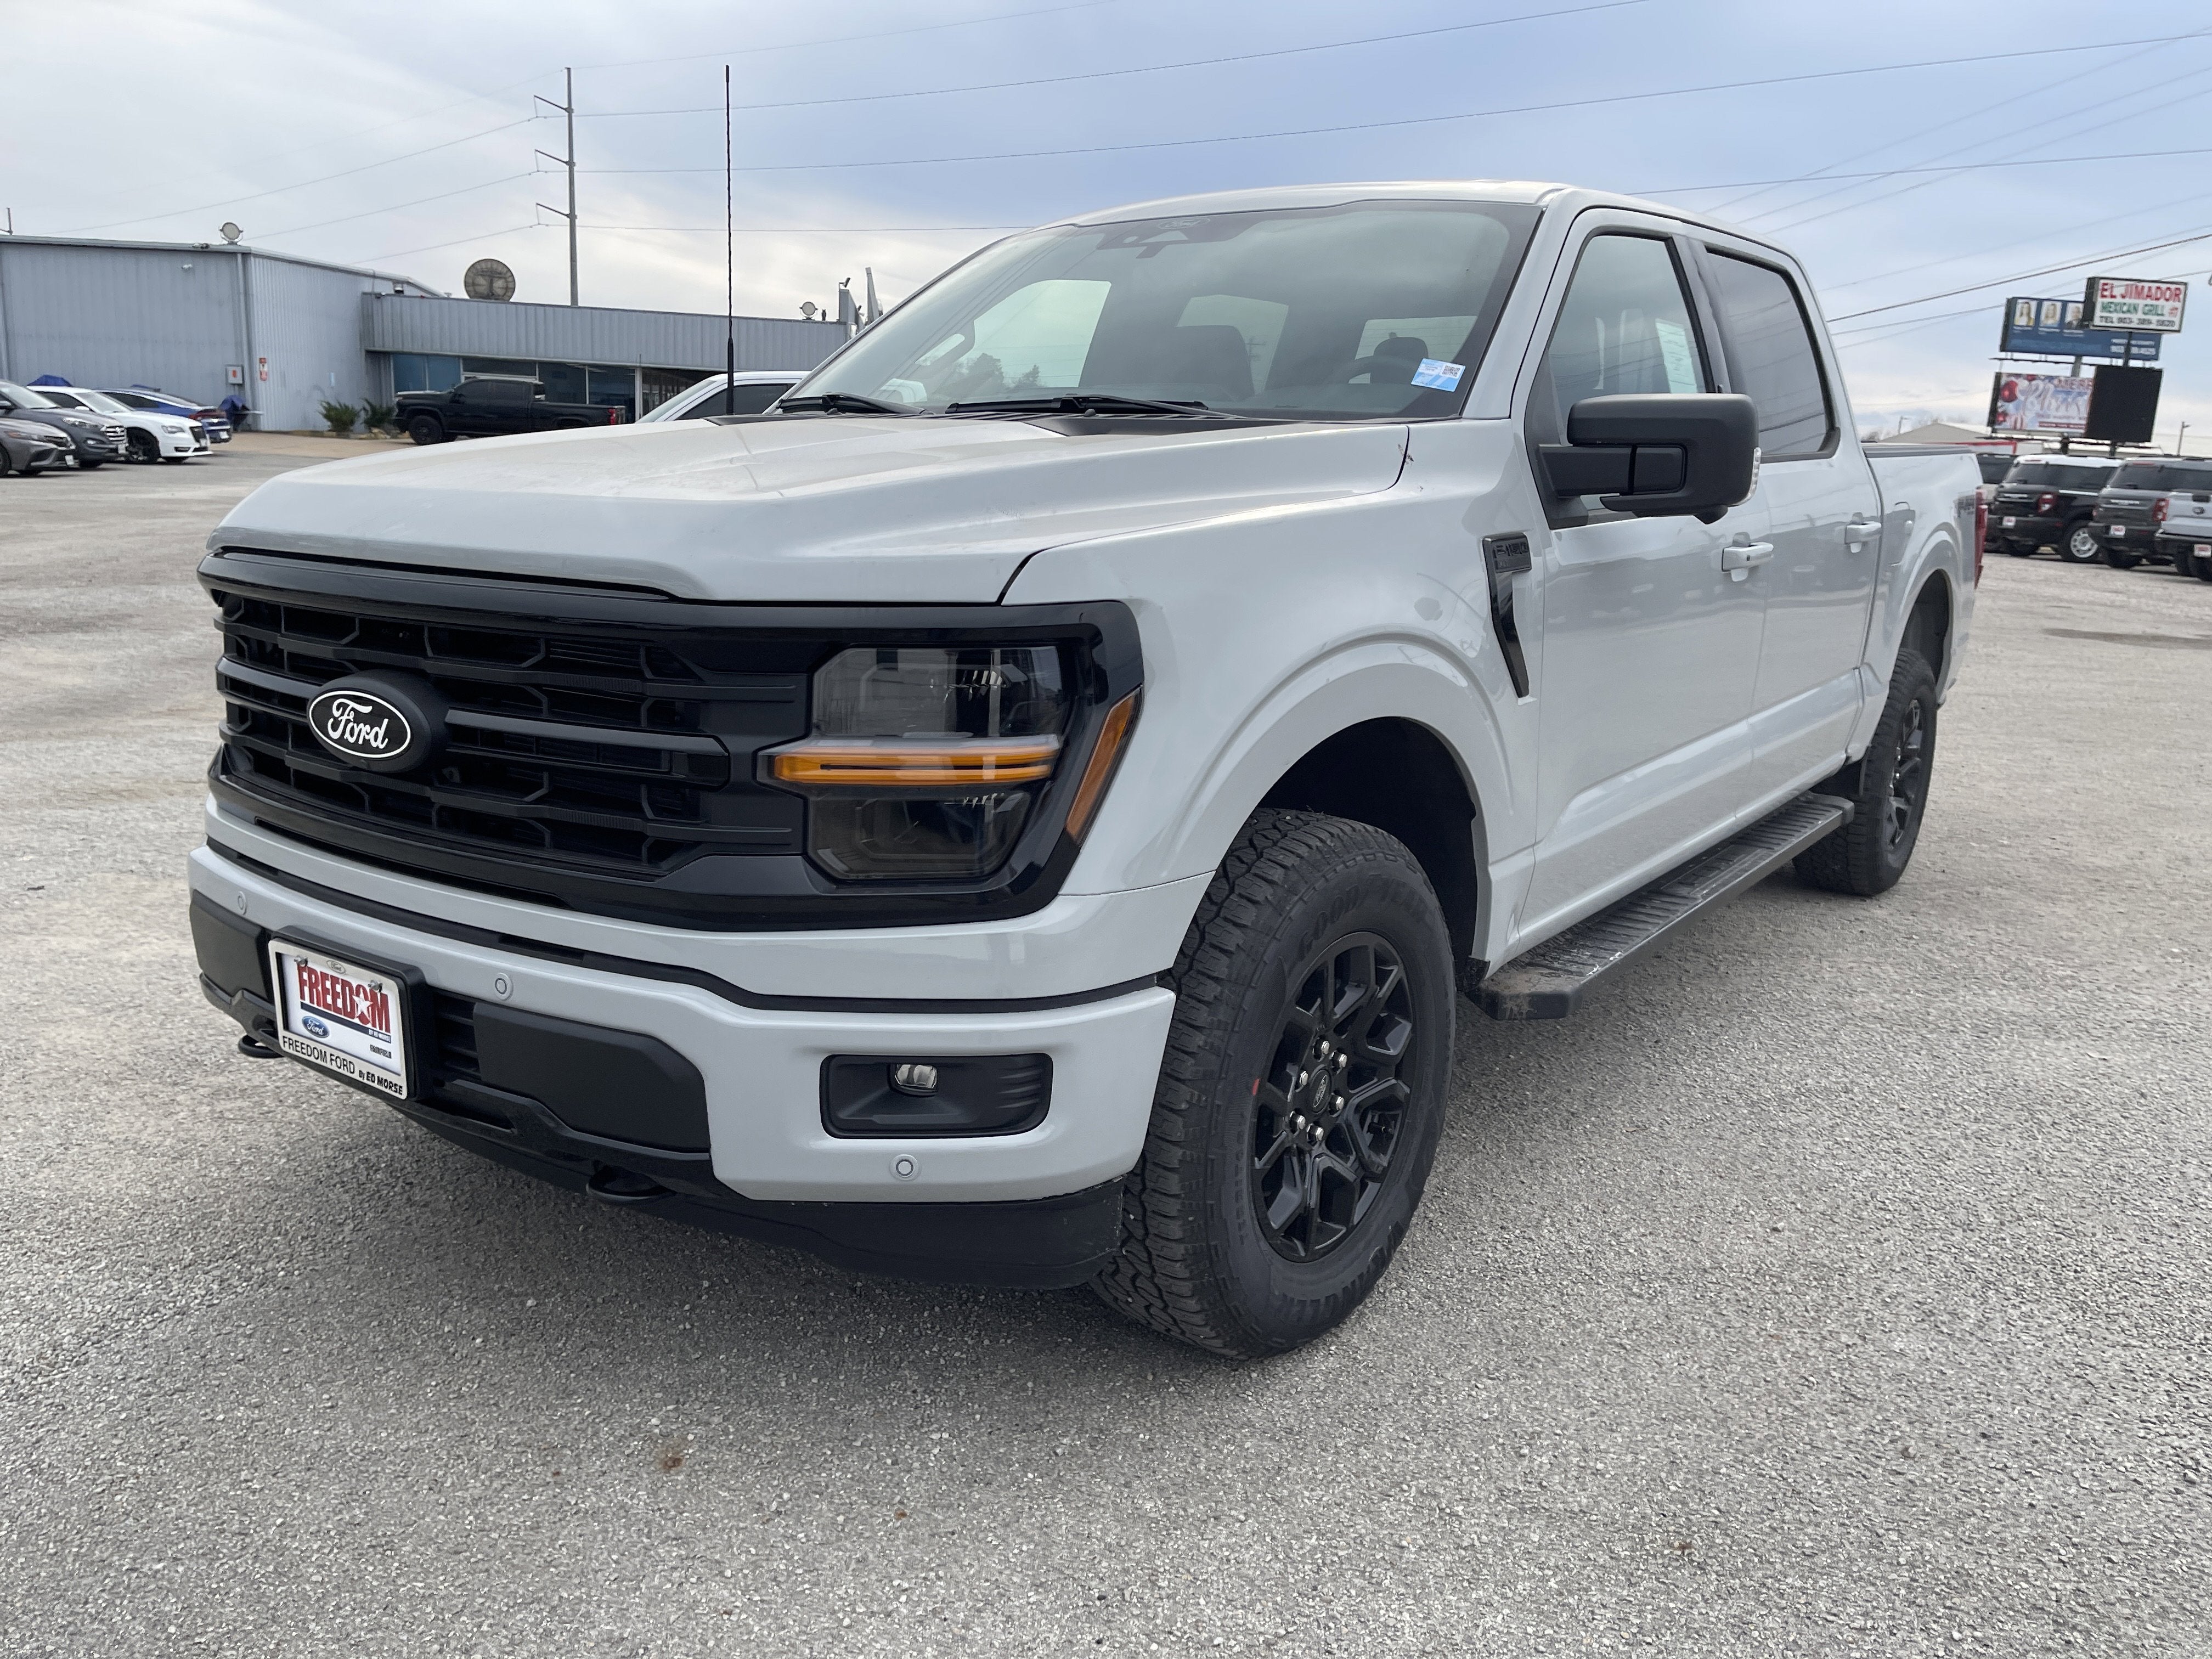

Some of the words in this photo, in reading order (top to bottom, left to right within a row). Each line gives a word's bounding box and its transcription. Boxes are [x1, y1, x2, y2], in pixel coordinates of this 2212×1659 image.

[2100, 283, 2116, 298] EL
[2120, 284, 2181, 302] JIMADOR
[2101, 302, 2138, 315] MEXICAN
[2142, 303, 2164, 317] GRILL
[328, 698, 389, 749] Ford
[297, 964, 391, 1034] FREEDOM
[307, 1019, 325, 1036] Ford
[283, 1035, 328, 1064] FREEDOM
[330, 1052, 356, 1075] FORD
[366, 1071, 376, 1084] ED
[377, 1075, 403, 1096] MORSE
